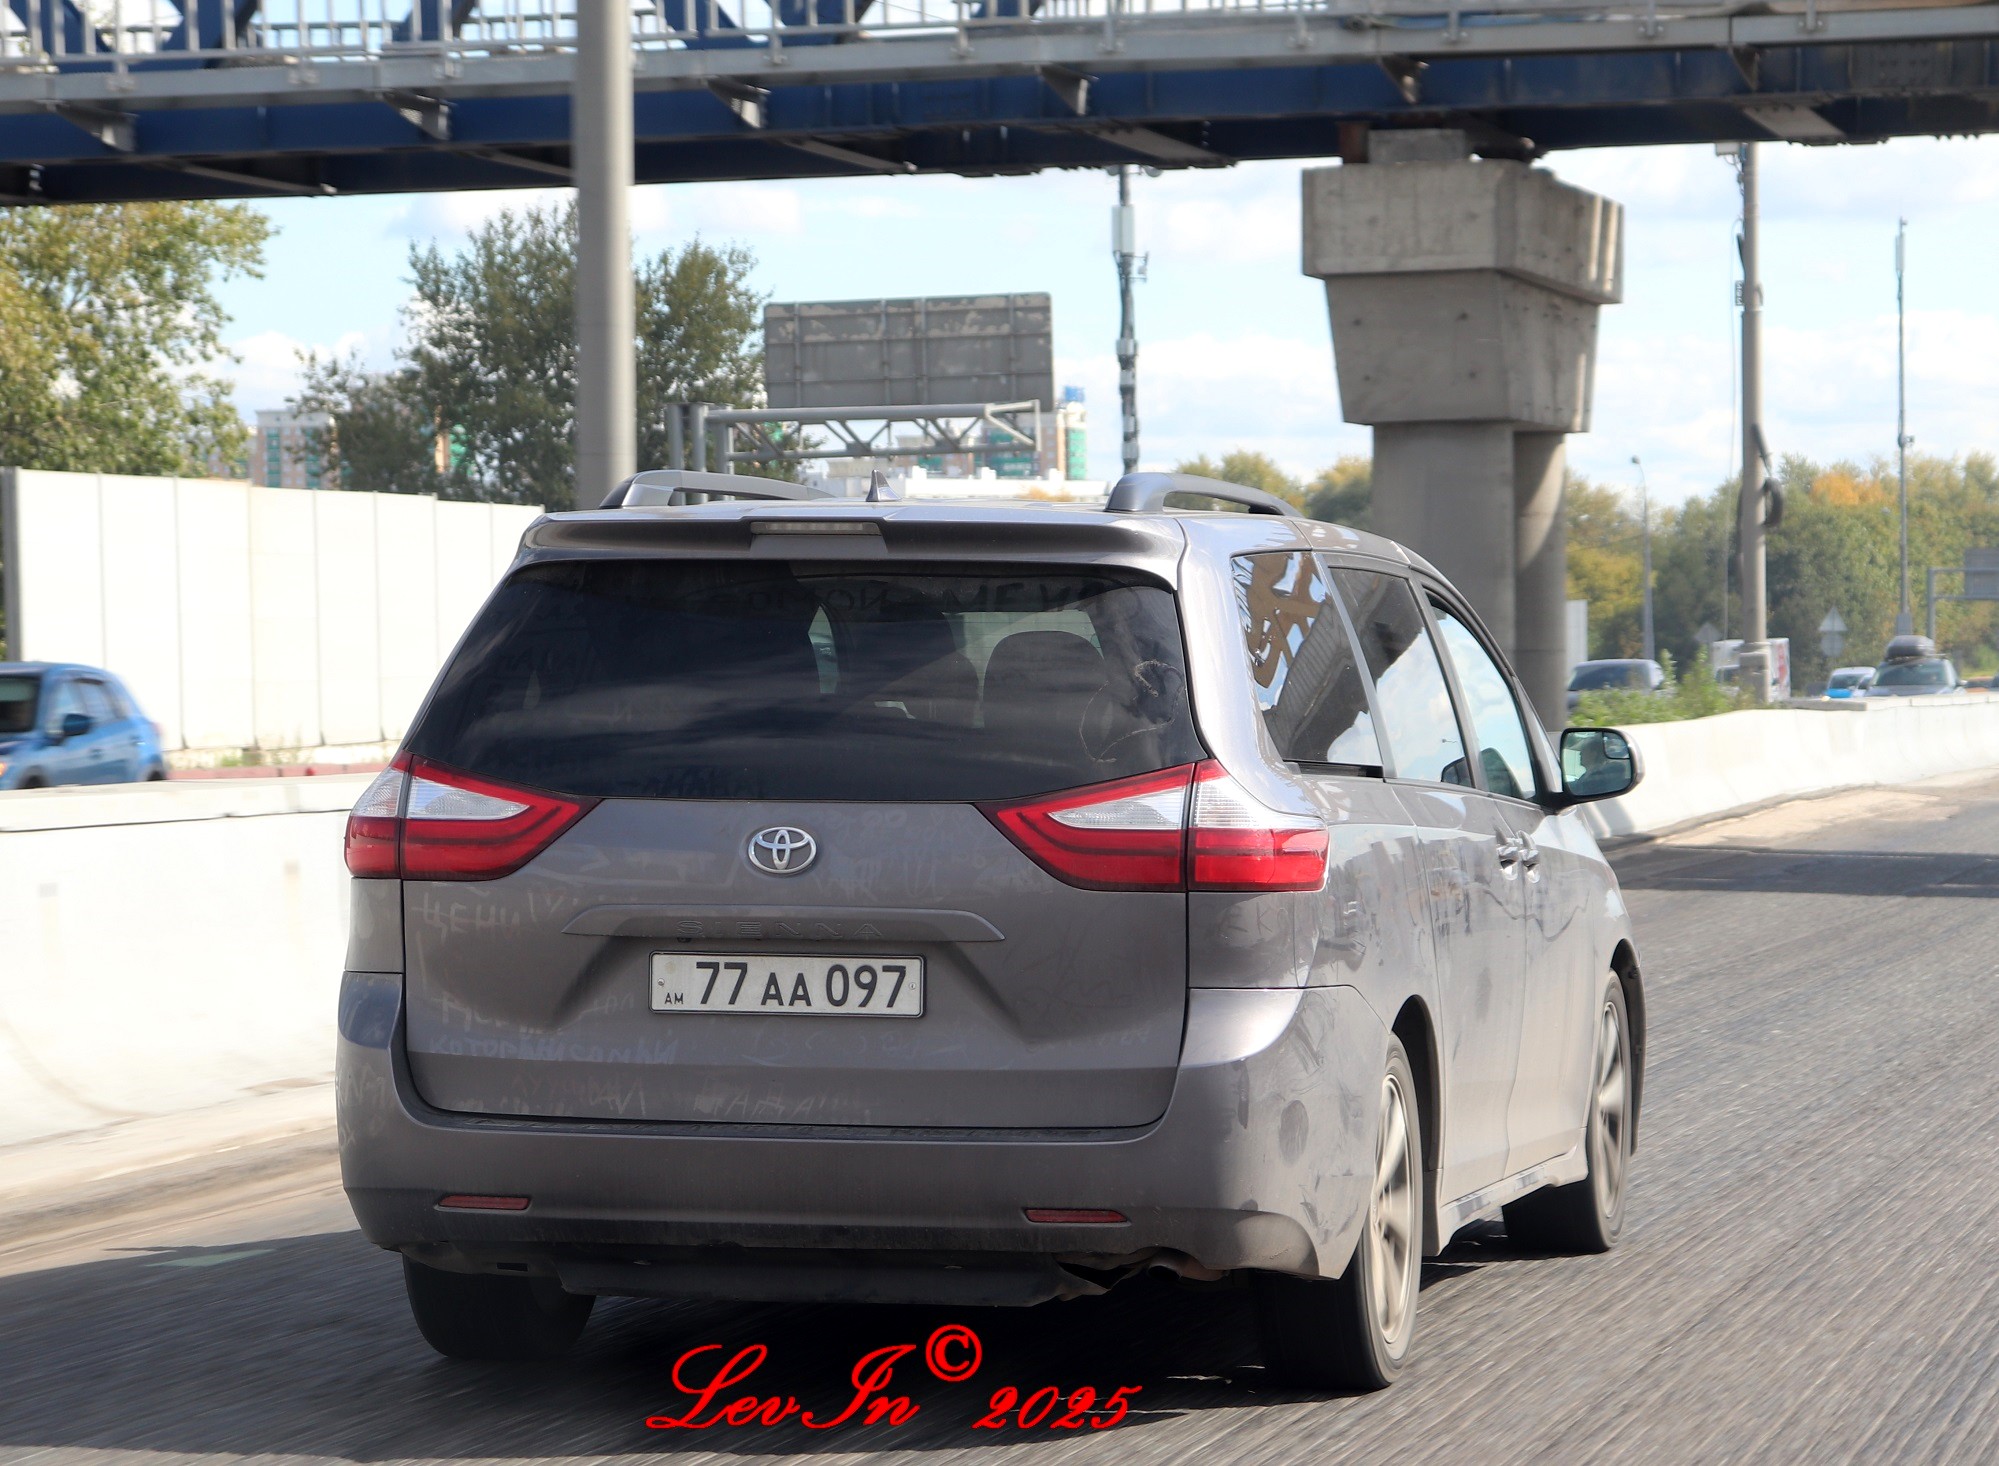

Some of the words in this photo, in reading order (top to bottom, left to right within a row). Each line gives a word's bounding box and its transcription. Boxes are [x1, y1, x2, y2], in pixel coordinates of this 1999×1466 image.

[664, 992, 685, 1005] AM
[696, 961, 748, 1005] 77
[760, 972, 812, 1006] AA
[826, 964, 907, 1008] 097
